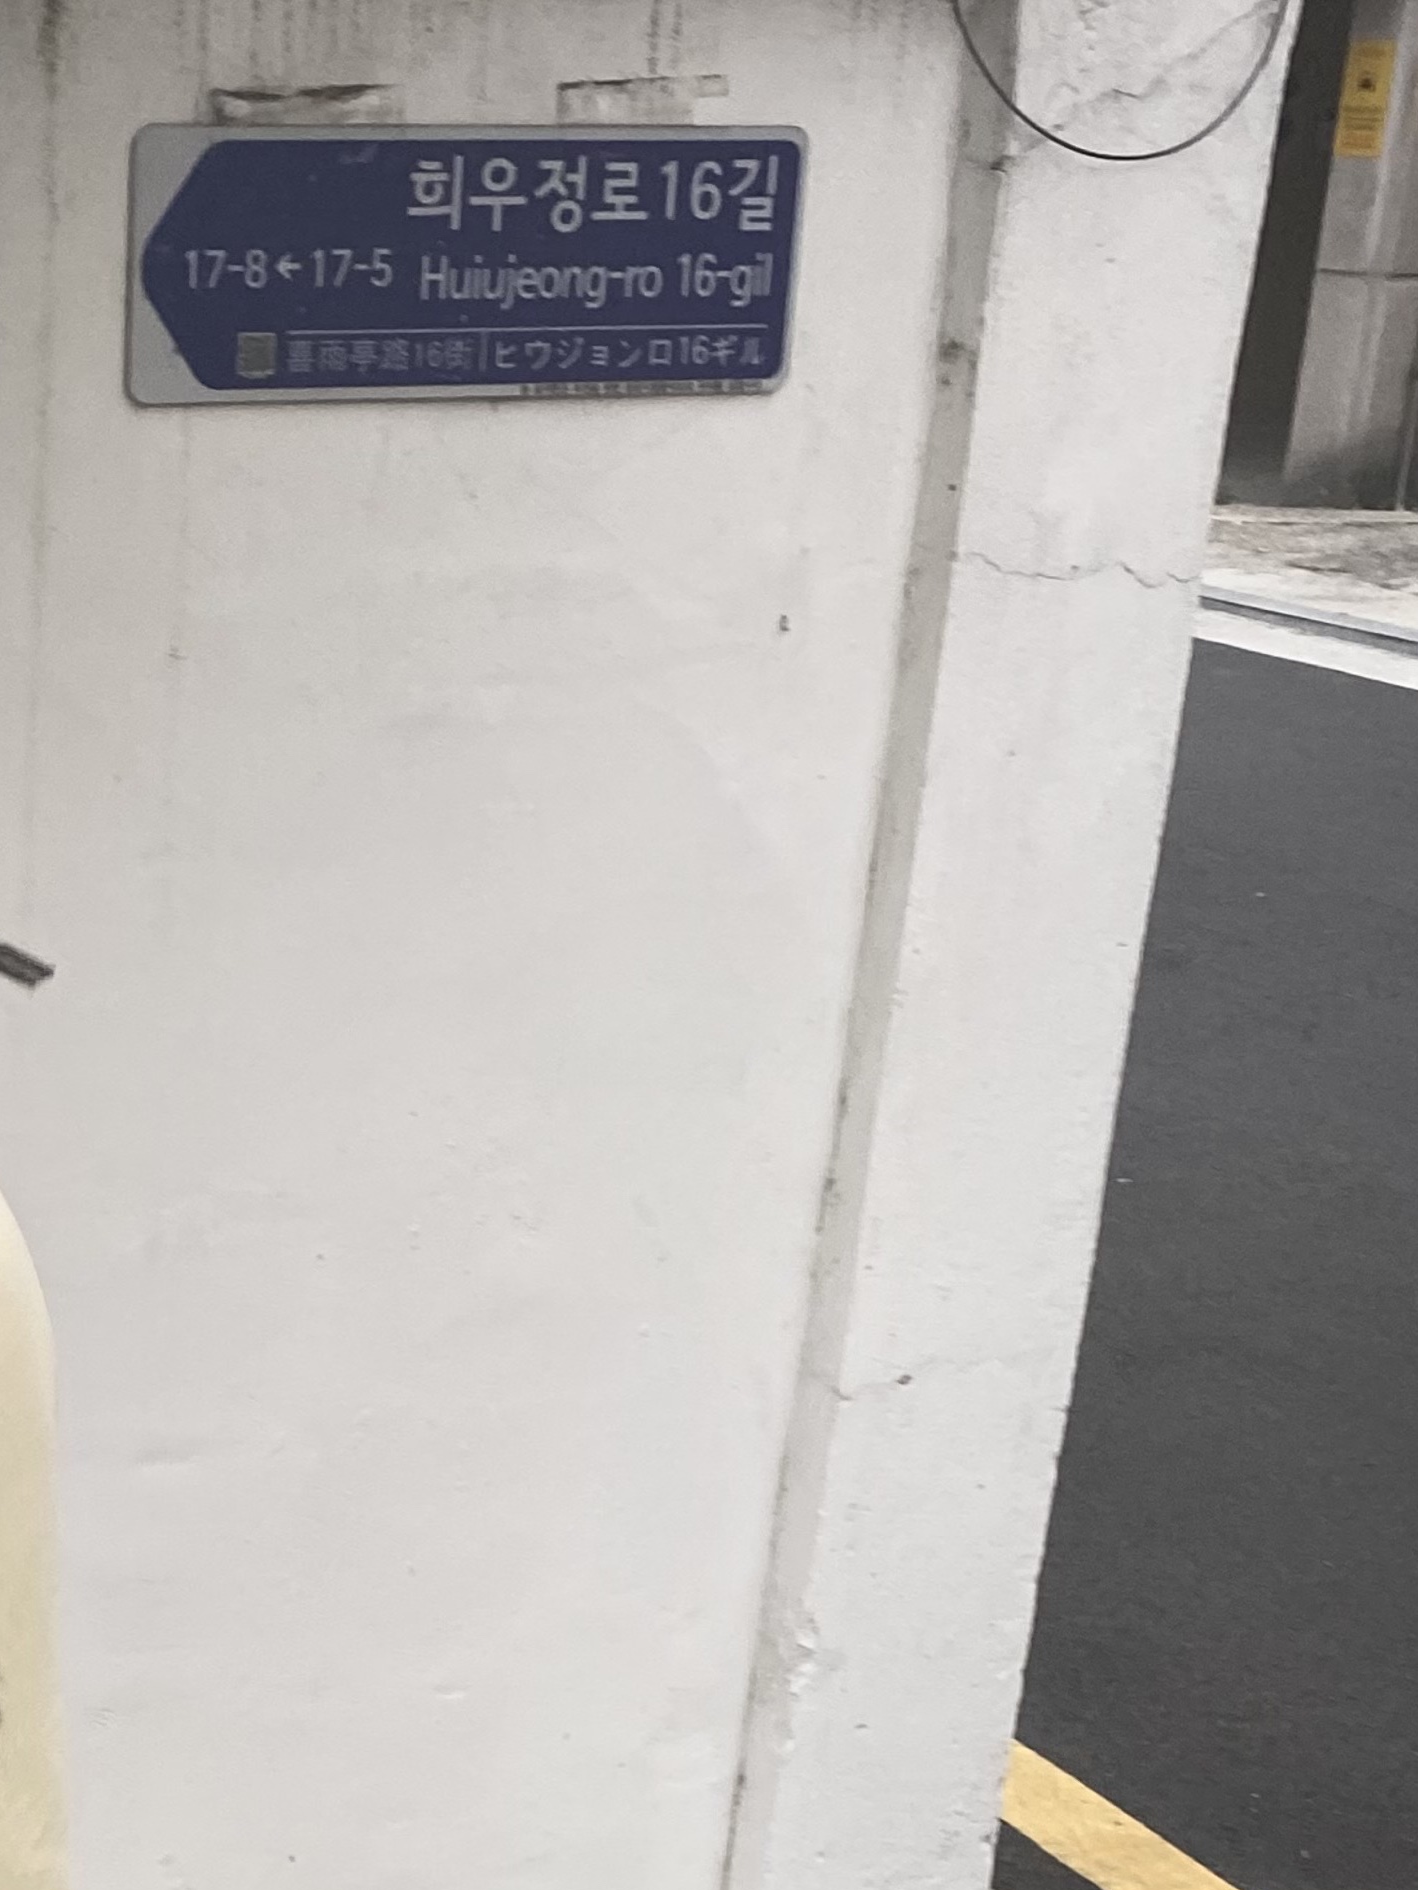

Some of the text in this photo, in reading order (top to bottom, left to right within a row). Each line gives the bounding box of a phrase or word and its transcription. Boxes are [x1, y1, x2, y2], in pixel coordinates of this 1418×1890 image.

[184, 248, 393, 289] 17-8 17-5
[420, 252, 774, 310] Huiujeong-ro 16-gil
